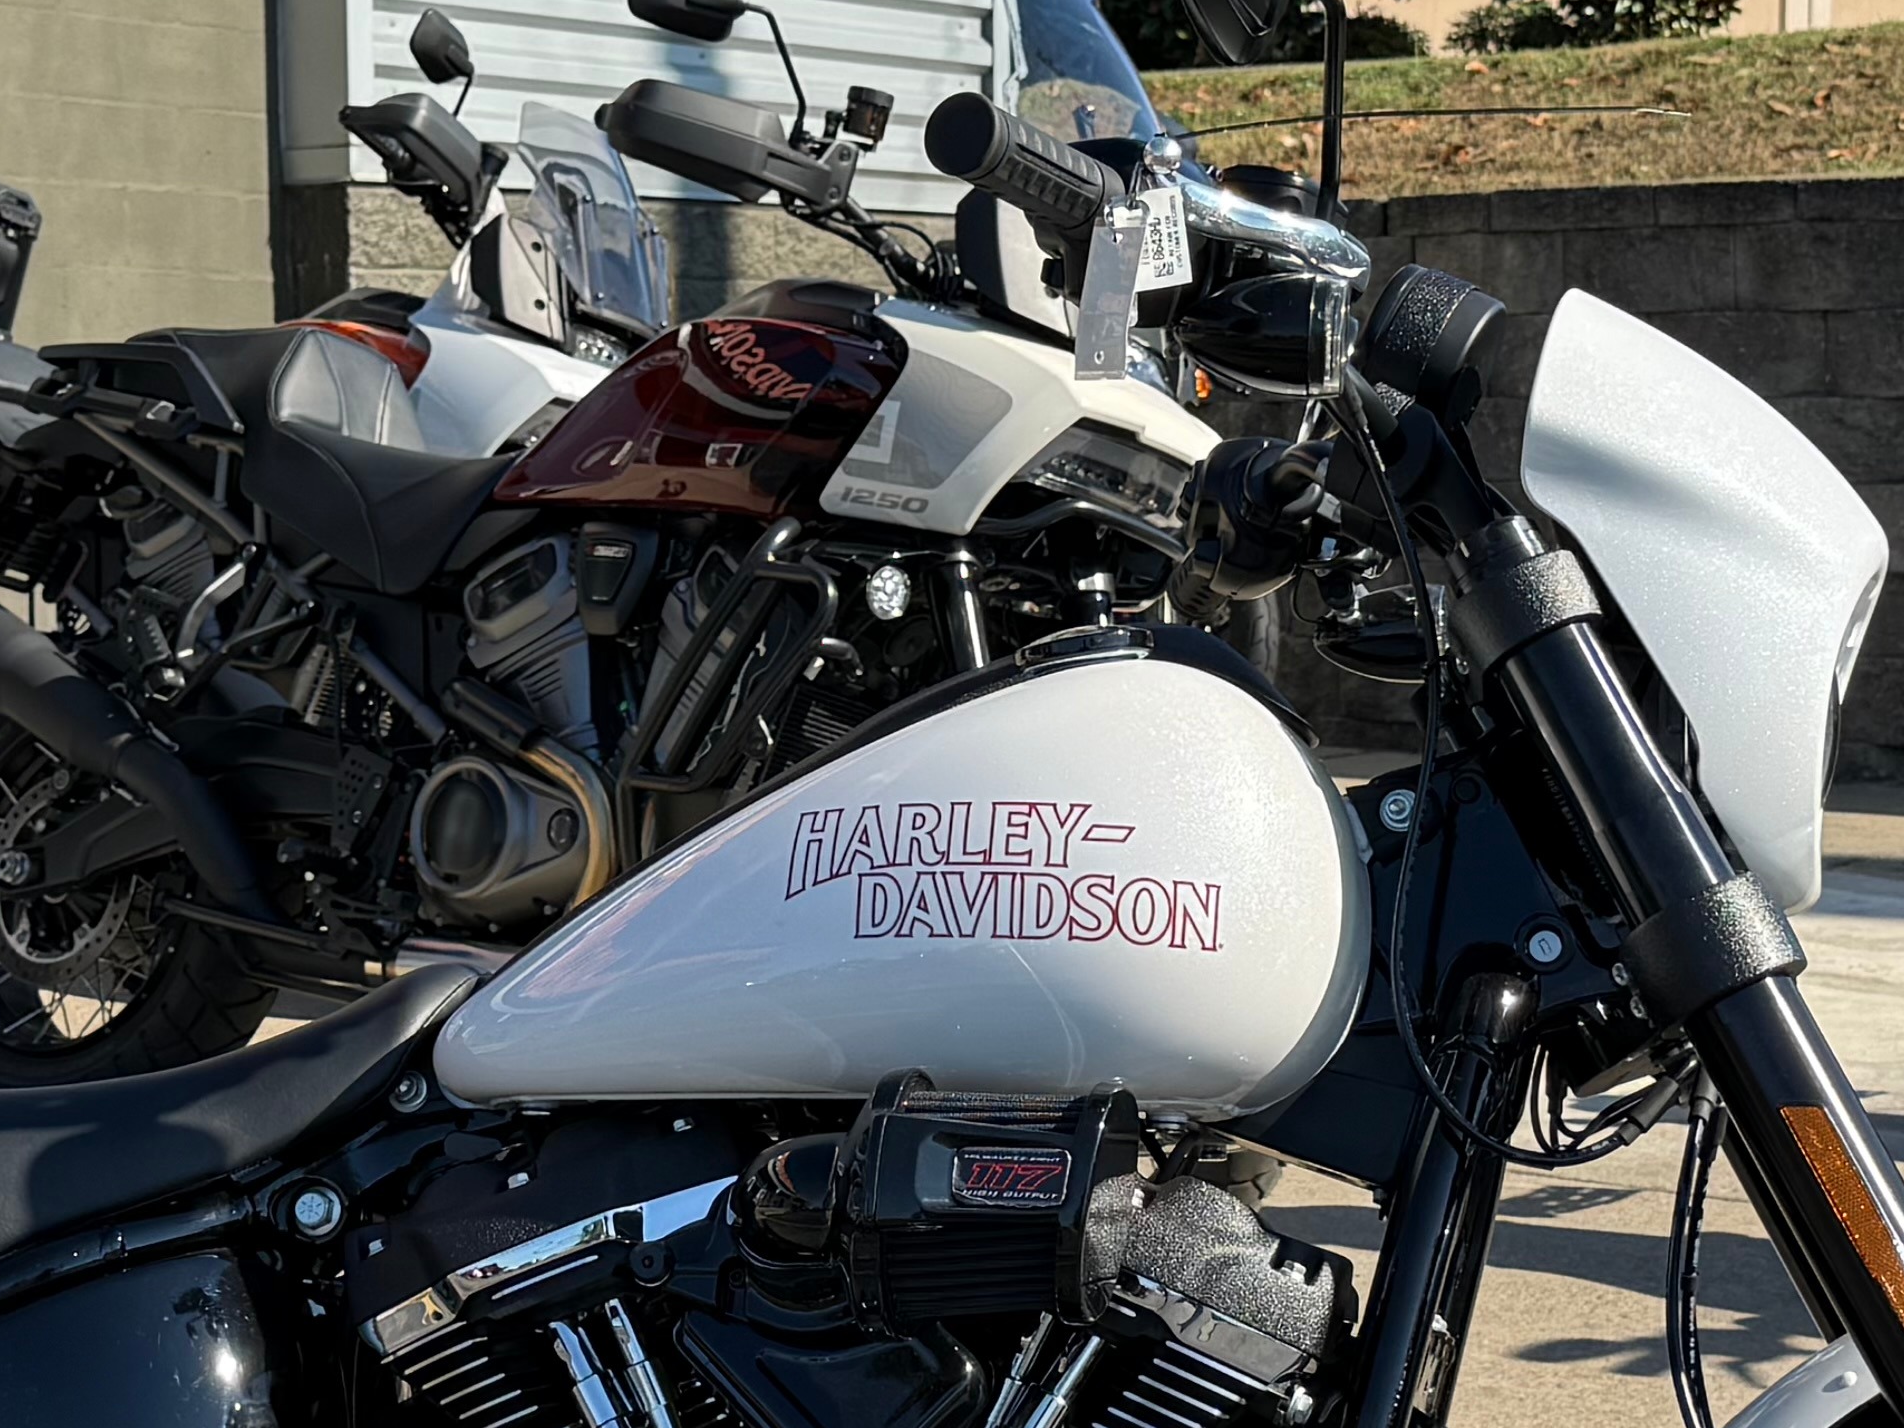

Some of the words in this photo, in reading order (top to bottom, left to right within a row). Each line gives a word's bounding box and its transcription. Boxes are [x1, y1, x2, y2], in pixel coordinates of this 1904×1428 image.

[840, 485, 930, 515] 1250
[785, 801, 1136, 901] HARLEY-
[854, 872, 1222, 952] DAVIDSON
[966, 1162, 1063, 1191] 117
[1002, 1189, 1060, 1200] OUTPUT
